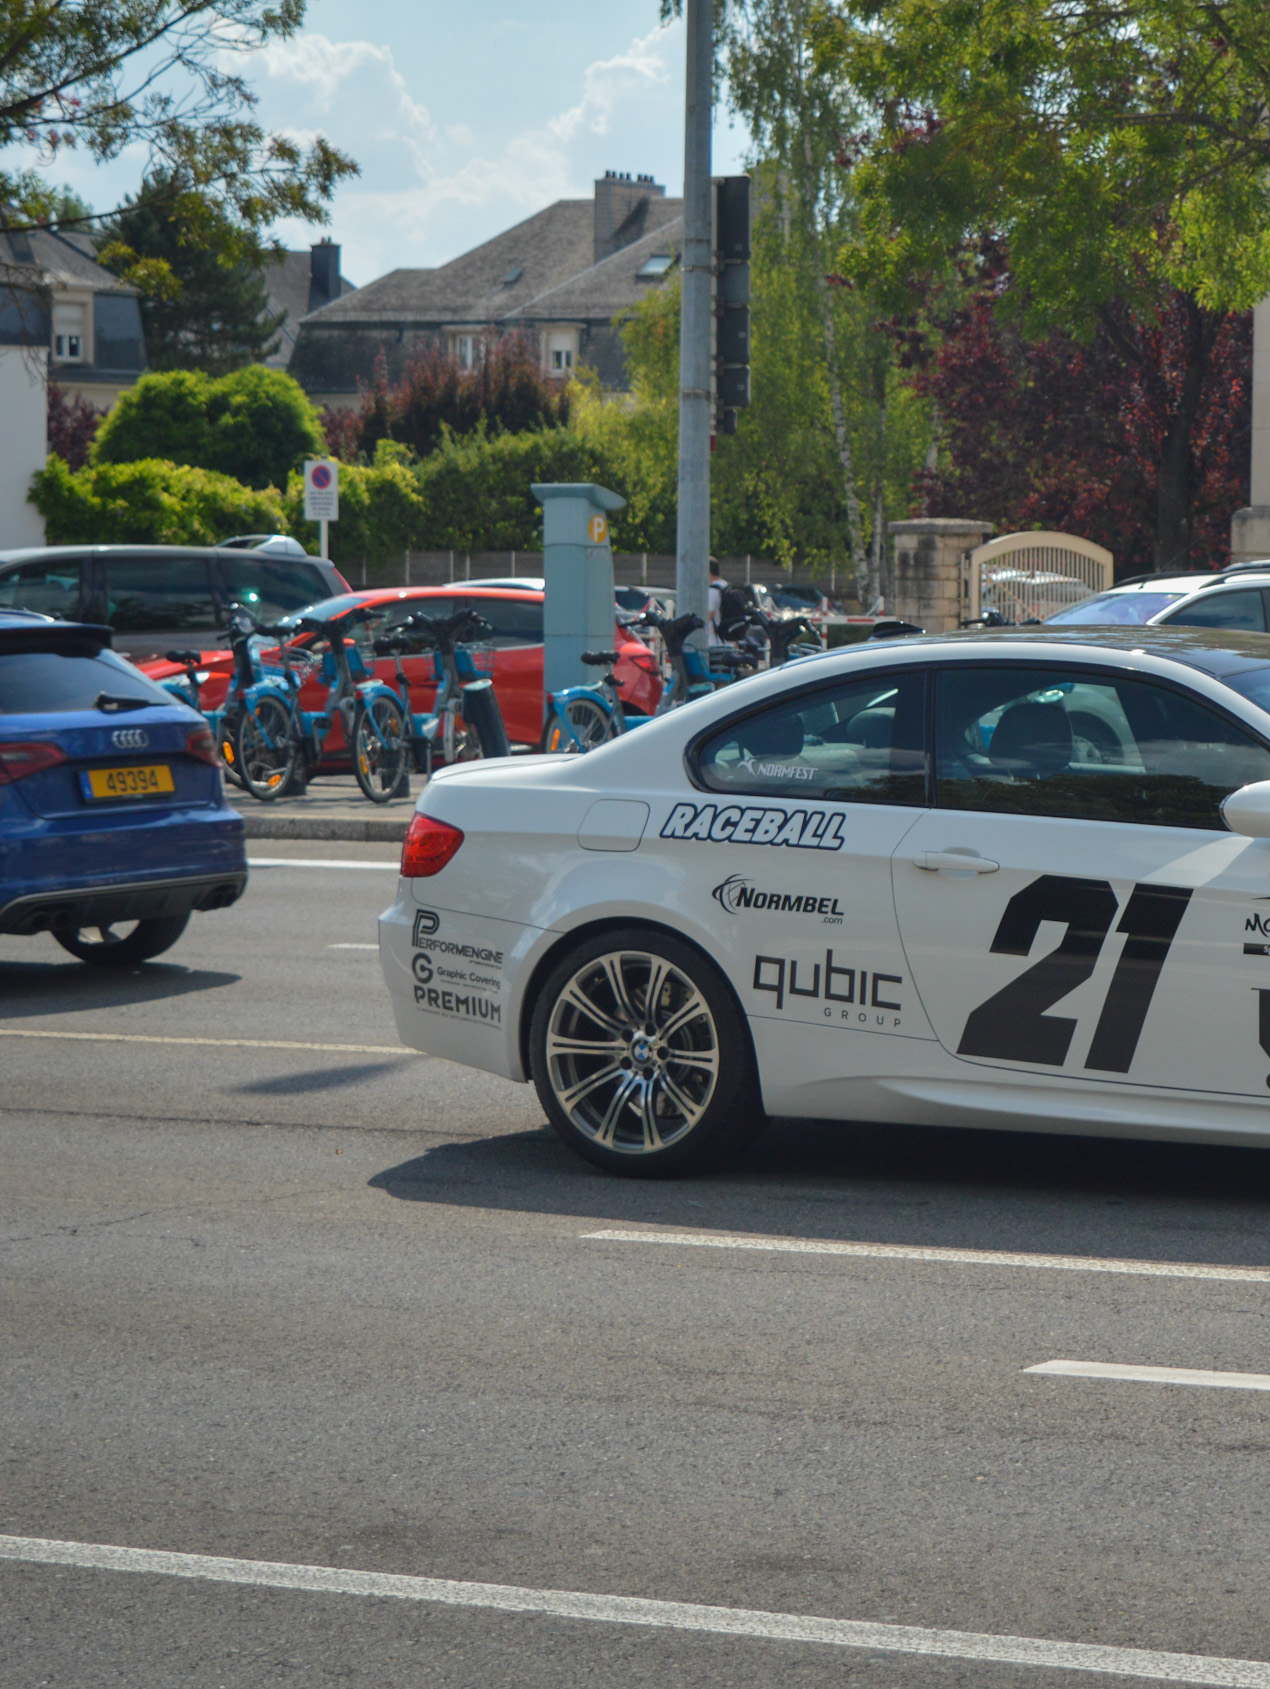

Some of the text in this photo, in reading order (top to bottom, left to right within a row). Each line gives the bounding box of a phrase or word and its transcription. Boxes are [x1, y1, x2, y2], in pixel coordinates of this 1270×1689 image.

[593, 518, 605, 542] P
[107, 769, 159, 792] 49394
[757, 763, 819, 780] NORMFEST
[660, 803, 847, 851] RACEBALL
[821, 916, 844, 925] .com
[412, 908, 504, 964] PERFORMENGINE
[437, 966, 467, 981] Graphic
[469, 972, 502, 991] Covering
[753, 949, 903, 1011] qubic
[956, 874, 1195, 1073] 21
[413, 984, 502, 1023] PREMIUM
[824, 1007, 901, 1028] GROUP
